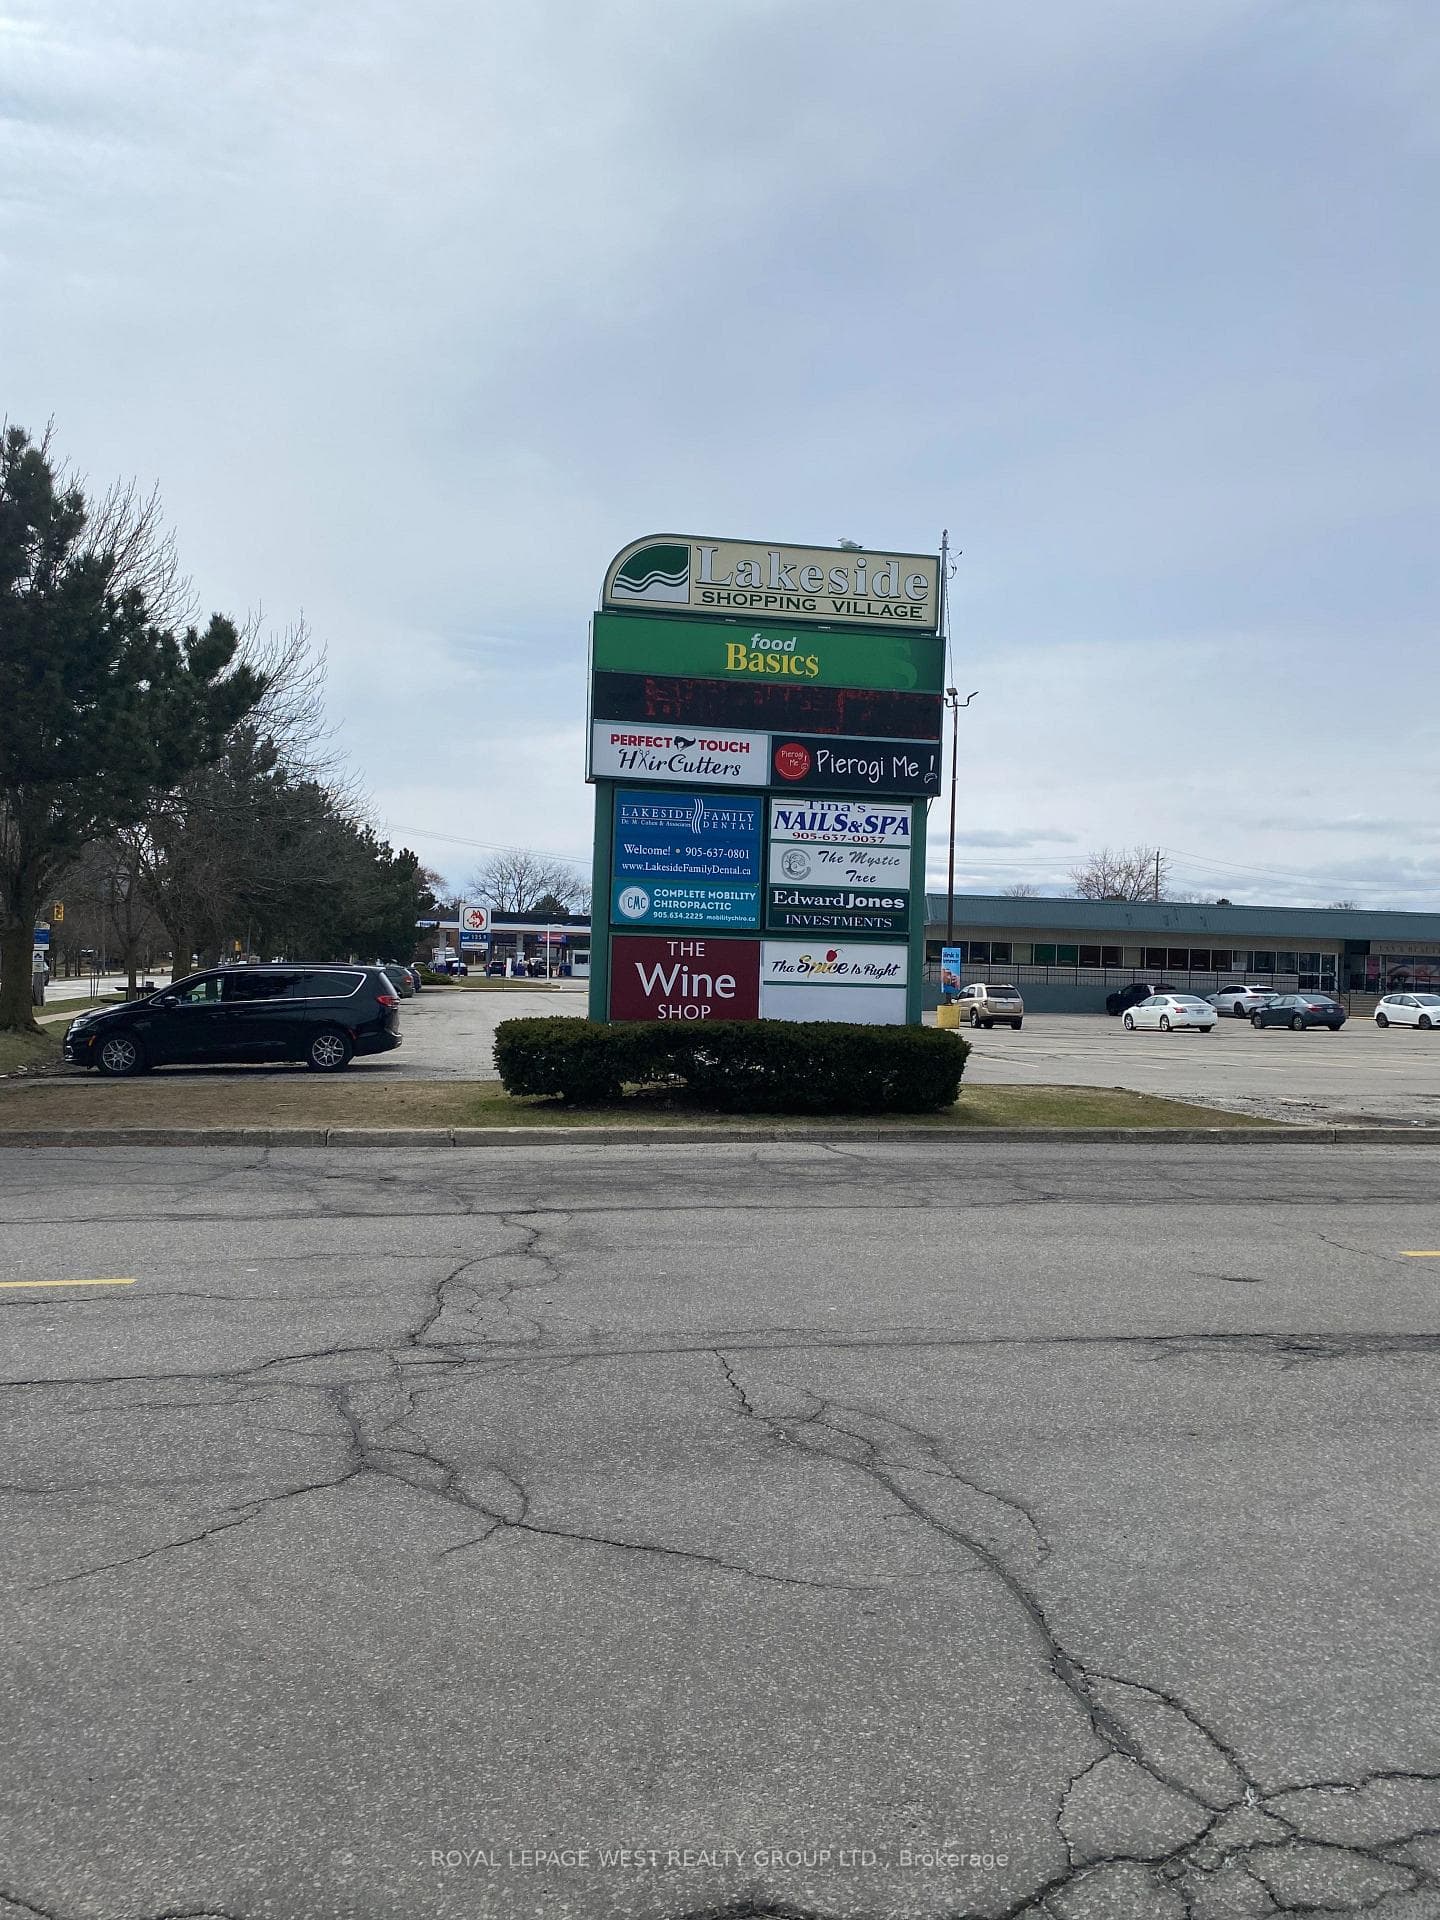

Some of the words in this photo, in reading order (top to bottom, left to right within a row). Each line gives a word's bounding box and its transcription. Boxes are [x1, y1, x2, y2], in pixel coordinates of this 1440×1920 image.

[696, 546, 929, 601] Lakeside
[702, 591, 816, 611] SHOPPING
[831, 599, 923, 619] VILLAGE
[751, 633, 796, 652] food
[611, 734, 672, 749] PERFECT
[698, 739, 750, 754] TOUCH
[817, 750, 884, 782] Pierogi
[892, 756, 919, 778] Me
[805, 800, 866, 813] Tina's
[622, 808, 693, 820] LAKESIDE
[704, 812, 754, 822] FAMILY
[703, 822, 754, 831] DENTAL
[793, 832, 885, 844] 905-637-0037
[624, 844, 671, 856] Welcome!
[686, 847, 750, 859] 905-637-0801
[818, 851, 852, 866] The
[854, 851, 901, 868] Mystic
[622, 861, 752, 876] www.LakesideFamilyDental.ca
[846, 870, 877, 884] Tree
[654, 889, 706, 898] COMPLETE
[708, 892, 756, 900] MOBILITY
[628, 896, 646, 909] CMC
[654, 900, 732, 910] CHIROPRACTIC
[786, 915, 892, 928] INVESTMENTS
[667, 941, 706, 957] THE
[797, 955, 849, 978] Spice
[851, 964, 862, 974] Is
[864, 963, 900, 979] Right
[635, 962, 736, 999] Wine
[658, 1004, 711, 1020] SHOP
